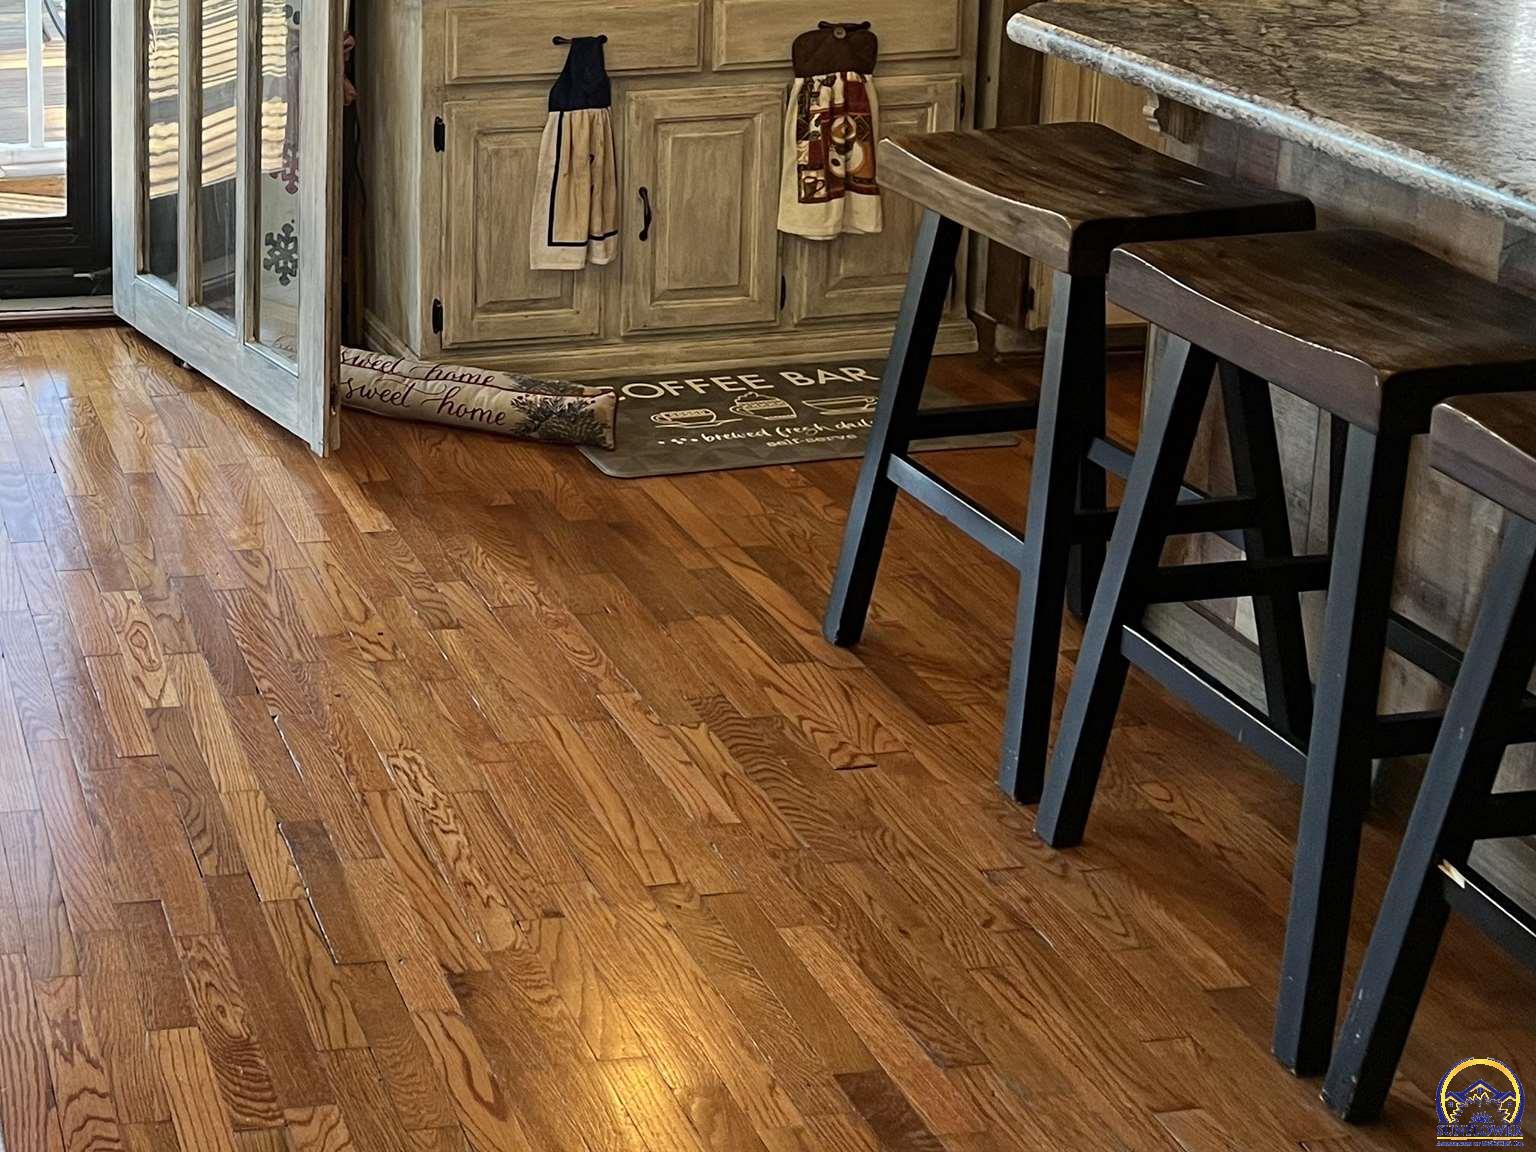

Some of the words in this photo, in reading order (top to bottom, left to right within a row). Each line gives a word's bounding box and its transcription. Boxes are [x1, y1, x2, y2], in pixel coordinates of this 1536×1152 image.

[619, 373, 774, 401] OFFEE
[779, 366, 880, 387] BAR
[341, 377, 417, 408] sweet
[421, 385, 506, 426] home
[701, 428, 772, 443] brewed
[766, 434, 858, 448] self-serve
